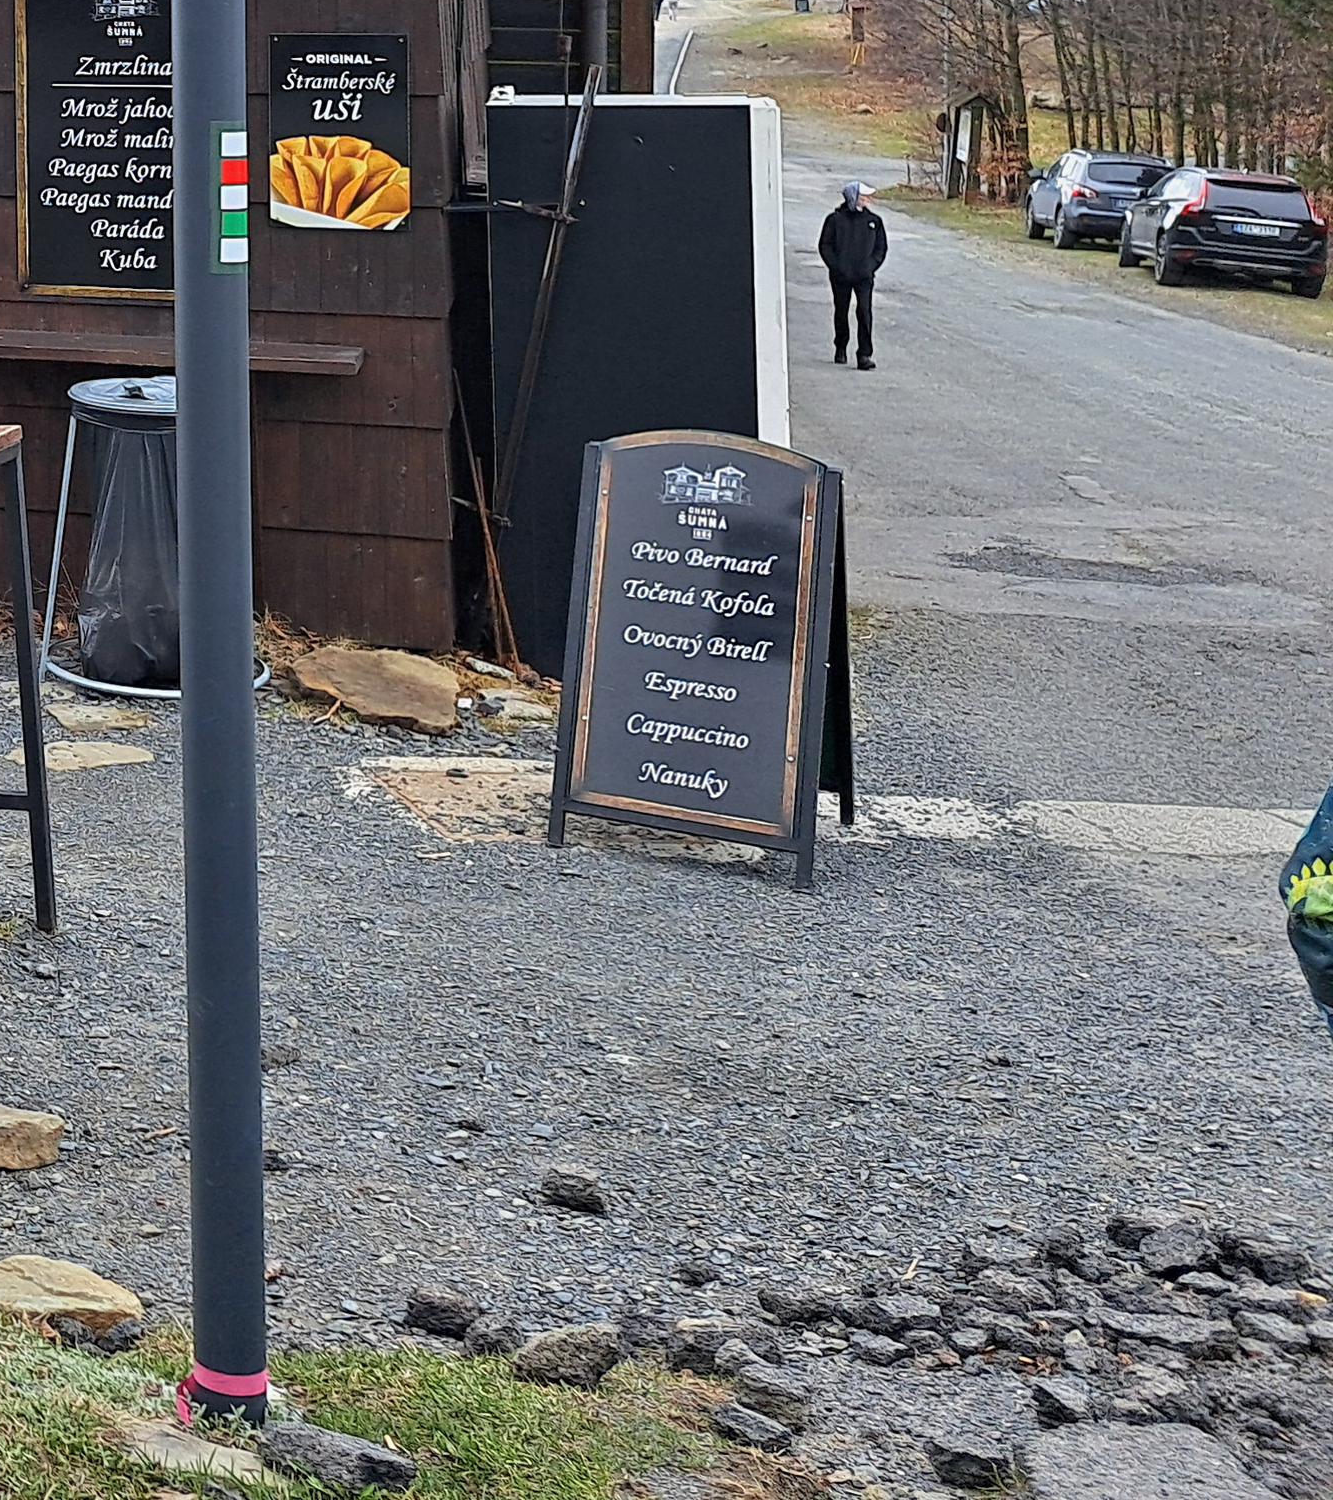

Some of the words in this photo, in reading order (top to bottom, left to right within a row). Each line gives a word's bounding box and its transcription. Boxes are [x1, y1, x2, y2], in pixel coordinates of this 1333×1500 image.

[75, 54, 173, 76] Zmrzlina
[305, 53, 373, 65] ORIGINAL
[281, 67, 397, 94] Štramberské
[61, 98, 119, 118] Mrož
[311, 92, 364, 121] uši
[60, 128, 119, 148] Mrož
[48, 158, 120, 184] Paegas
[40, 187, 112, 214] Paegas
[90, 218, 165, 239] Paráda
[100, 248, 158, 272] Kuba
[677, 510, 728, 530] ŠUMNÁ
[631, 541, 681, 564] Pivo
[684, 548, 779, 576] Bernard
[623, 579, 696, 606] Točená
[700, 590, 775, 617] Kofola
[623, 625, 704, 658] Ovocný
[706, 637, 774, 662] Birell
[644, 671, 738, 702] Espresso
[626, 713, 750, 749] Cappuccino
[638, 762, 729, 799] Nanuky
